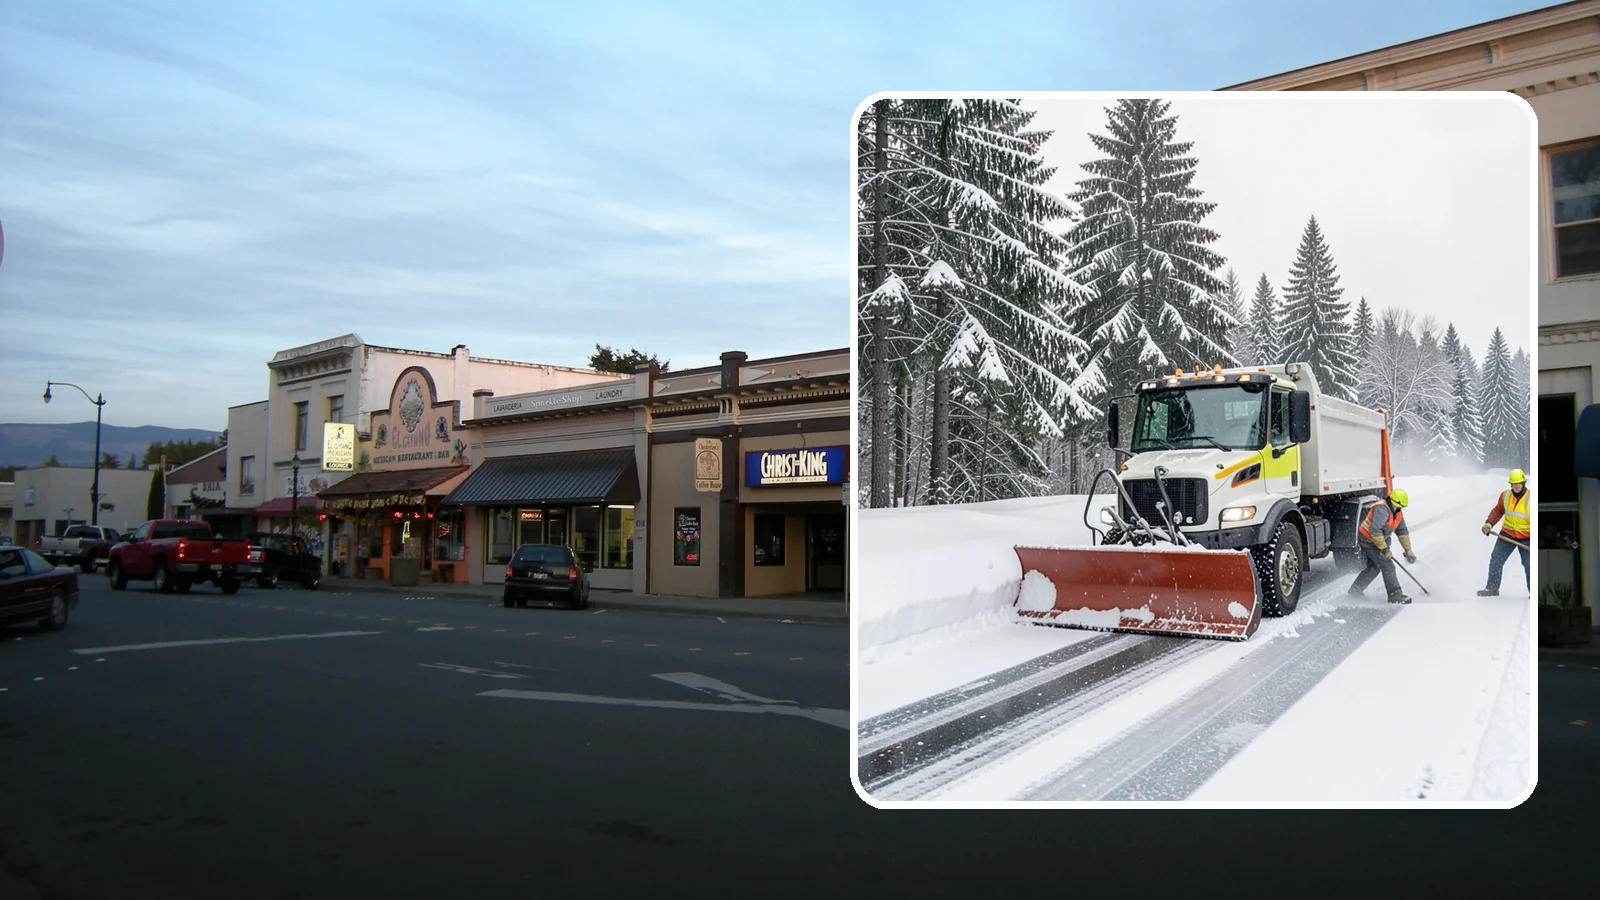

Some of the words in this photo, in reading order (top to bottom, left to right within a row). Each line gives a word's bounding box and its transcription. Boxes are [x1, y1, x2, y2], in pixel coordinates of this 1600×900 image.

[494, 402, 523, 413] LAVANDERIA
[561, 395, 582, 405] Shop
[595, 389, 624, 400] LAUNDRY
[374, 454, 396, 464] MEXICAN
[398, 451, 433, 462] RESTAURANT
[438, 450, 450, 459] BAR
[761, 452, 797, 478] CHRIST
[799, 450, 827, 476] KING
